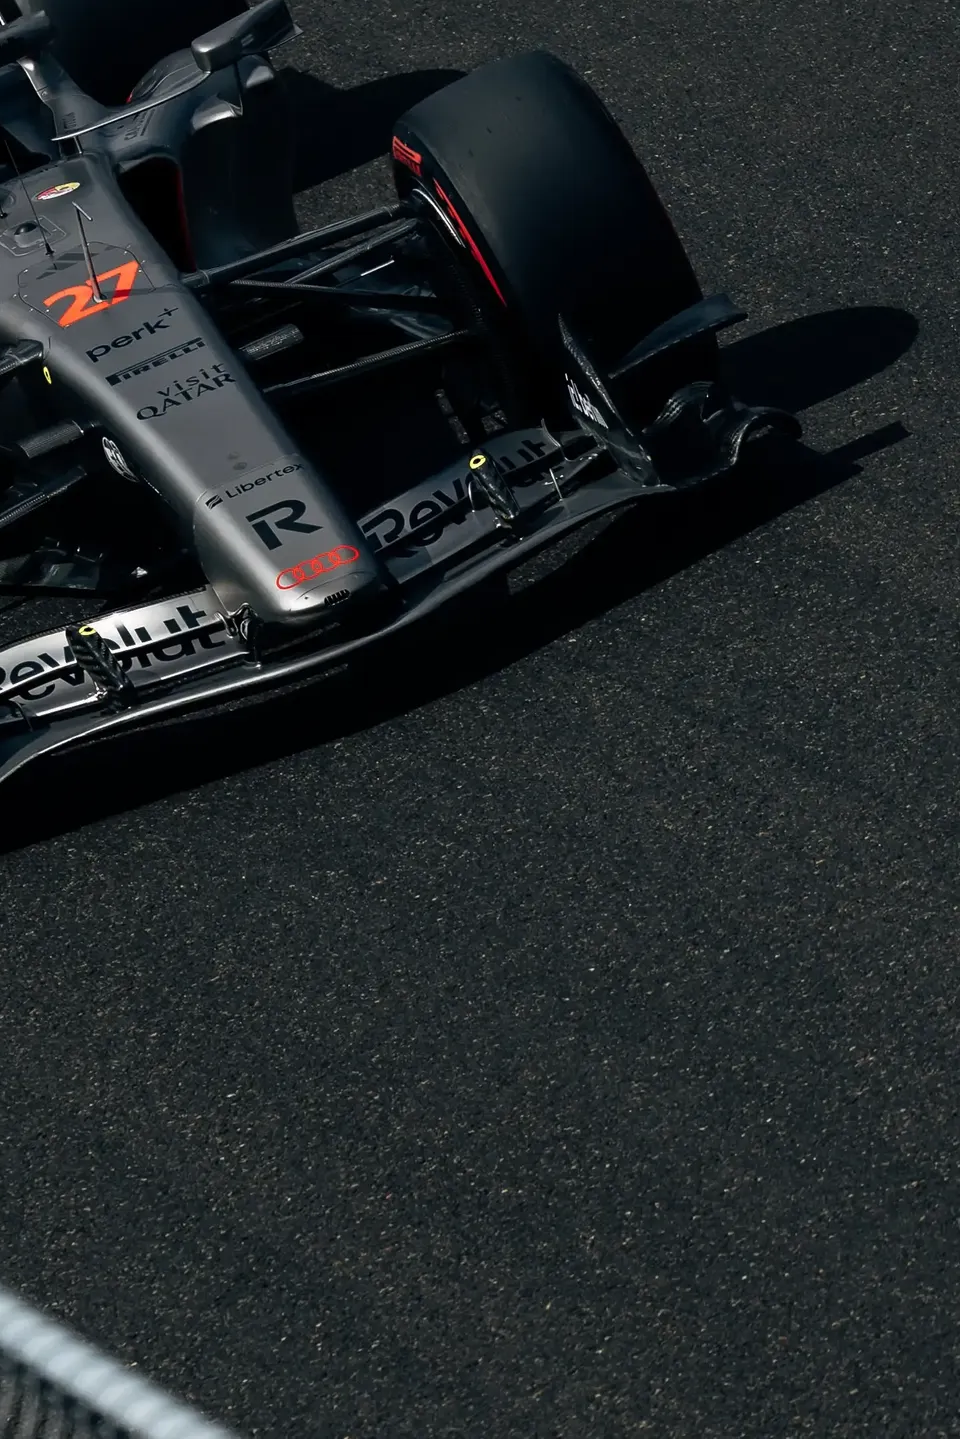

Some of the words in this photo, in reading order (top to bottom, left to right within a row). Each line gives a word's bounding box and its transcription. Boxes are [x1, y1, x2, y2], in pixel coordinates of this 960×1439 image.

[43, 261, 141, 328] 27
[105, 337, 206, 386] PIRELLI
[157, 363, 226, 397] visit
[137, 374, 236, 420] QATAR
[225, 462, 305, 498] Libertex
[245, 499, 324, 551] R
